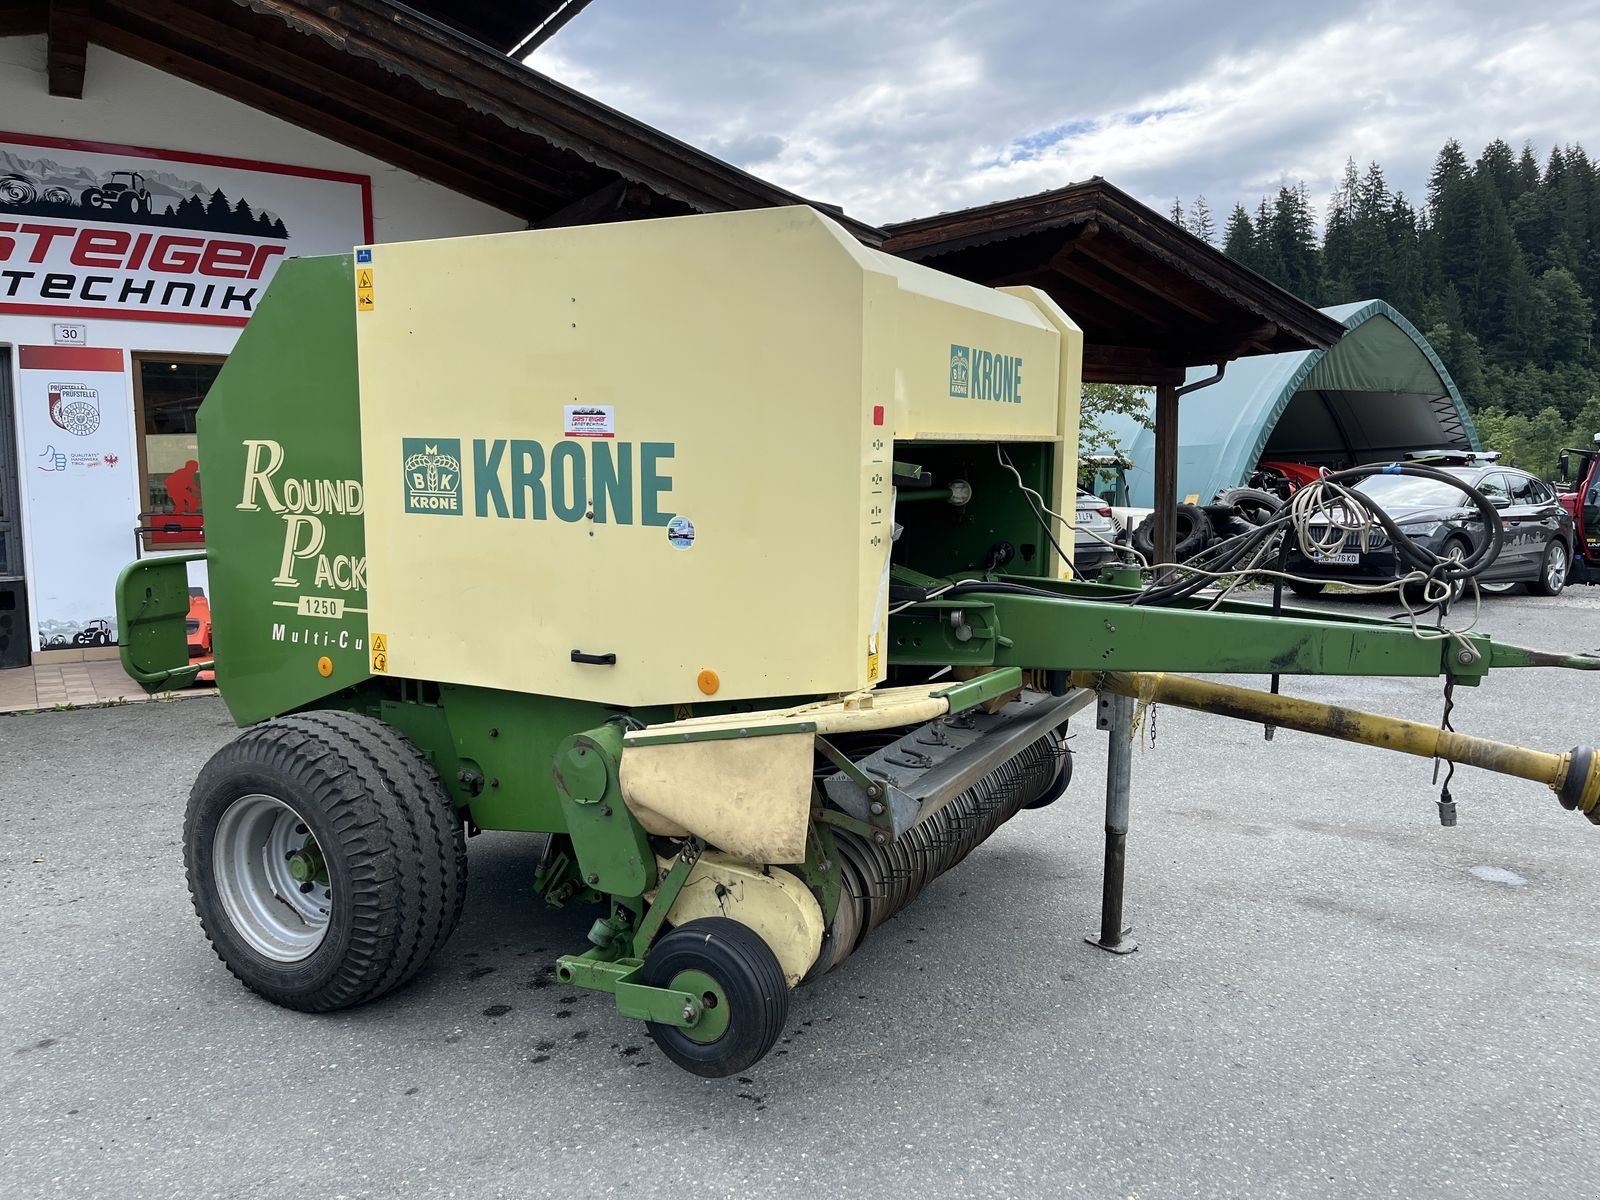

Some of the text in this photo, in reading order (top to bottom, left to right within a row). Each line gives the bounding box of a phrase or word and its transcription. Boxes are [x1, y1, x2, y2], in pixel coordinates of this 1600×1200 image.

[62, 329, 78, 339] 30
[971, 348, 1023, 404] KRONE
[62, 390, 96, 398] PRÜFSTELLE
[473, 438, 677, 527] KRONE
[410, 496, 458, 510] KRONE
[272, 514, 367, 591] PACK
[306, 599, 337, 617] 1250
